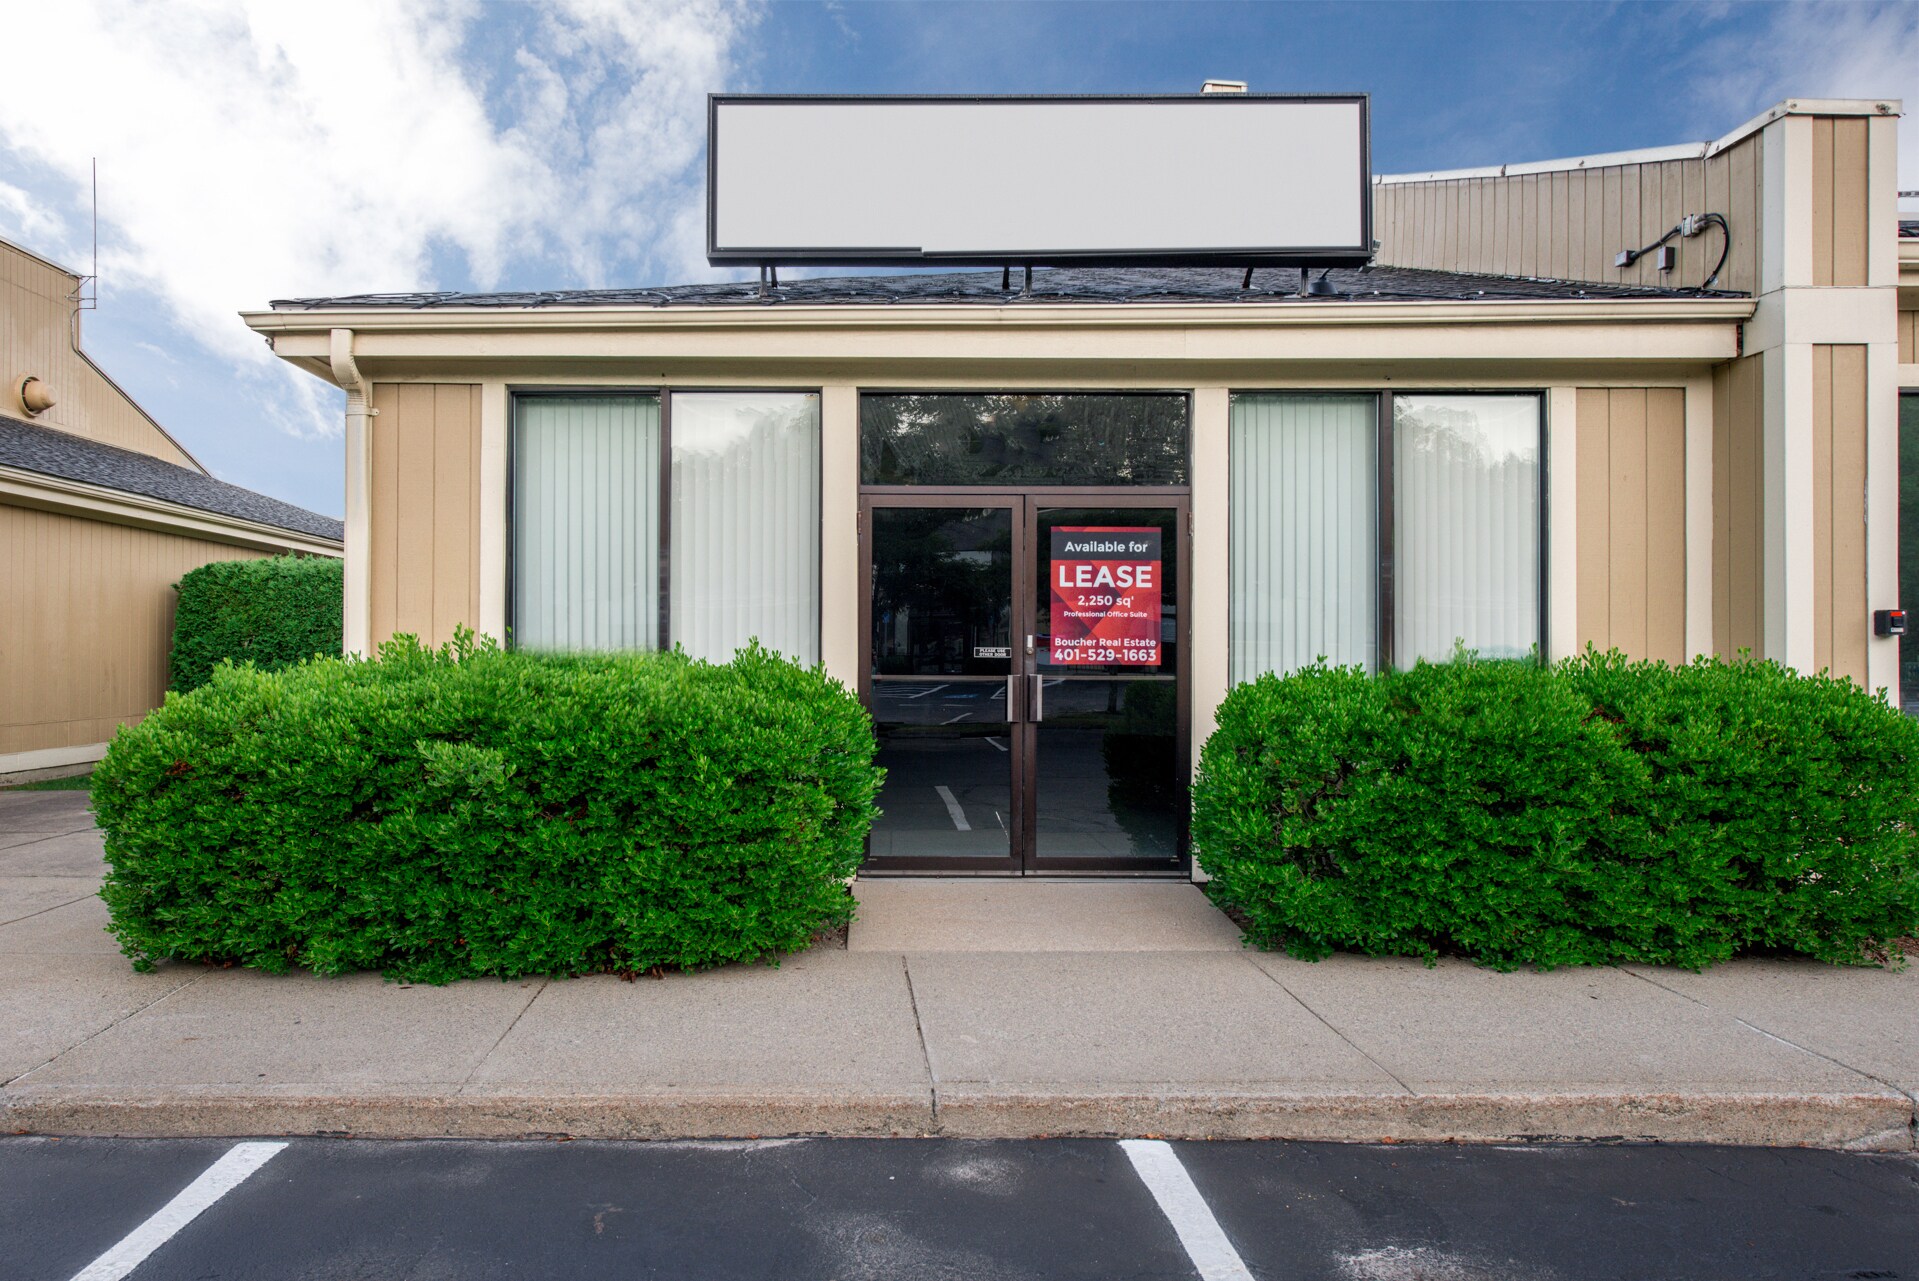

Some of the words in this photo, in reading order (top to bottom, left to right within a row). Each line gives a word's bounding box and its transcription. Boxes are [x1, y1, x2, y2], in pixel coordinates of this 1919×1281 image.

[1064, 541, 1126, 552] Available
[1128, 541, 1148, 552] for
[1059, 565, 1152, 588] LEASE
[1077, 595, 1113, 607] 2,250
[1055, 638, 1096, 647] Boucher
[1099, 638, 1121, 647] Real
[1123, 638, 1156, 647] Estate
[1055, 648, 1157, 661] 401-529-1663
